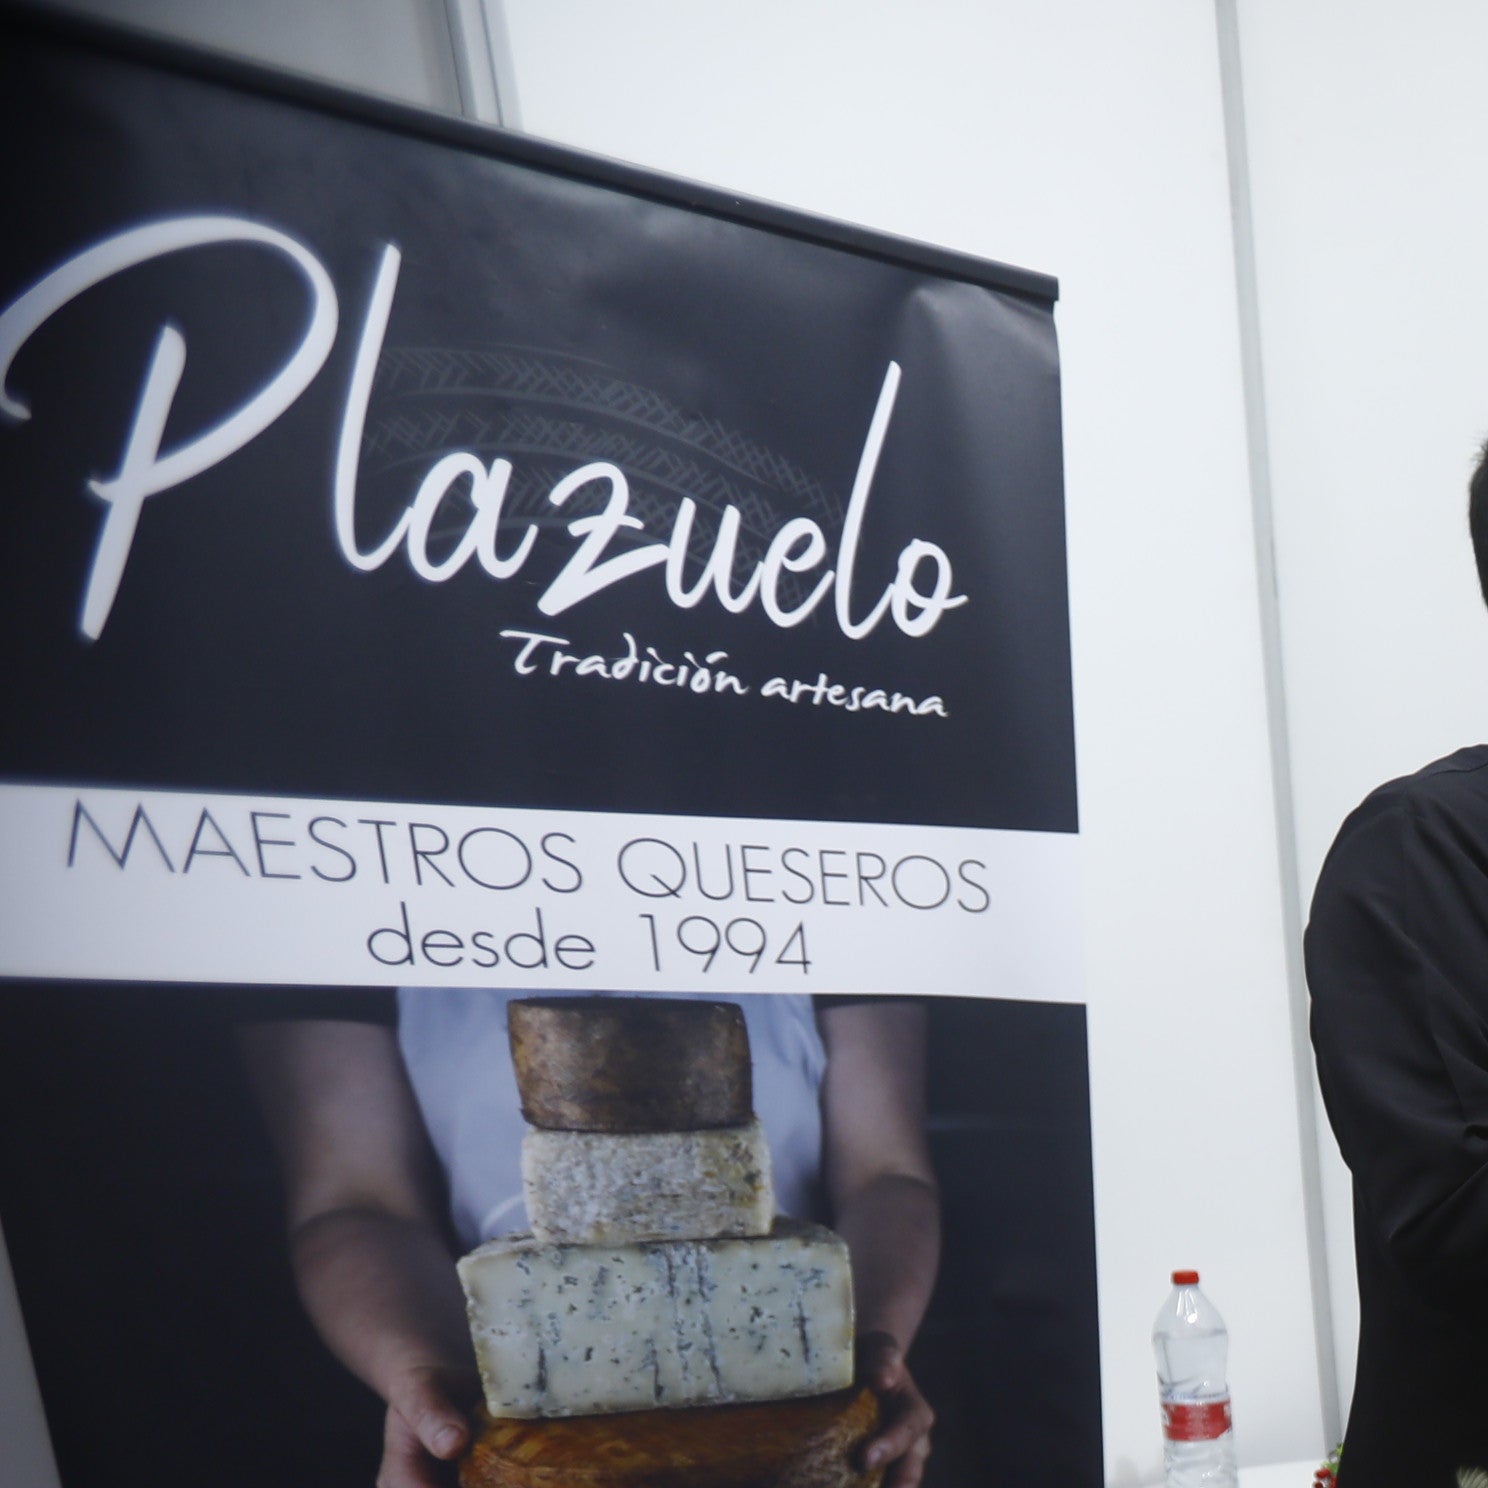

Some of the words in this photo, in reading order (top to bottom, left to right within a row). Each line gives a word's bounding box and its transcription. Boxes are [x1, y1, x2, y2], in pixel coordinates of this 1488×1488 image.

[0, 215, 969, 642] Plazuelo
[499, 629, 749, 697] Tradición
[760, 667, 949, 719] artesana
[65, 798, 585, 897] MAESTROS
[616, 836, 993, 915] QUESEROS
[366, 902, 598, 972] desde
[637, 912, 814, 976] 1994
